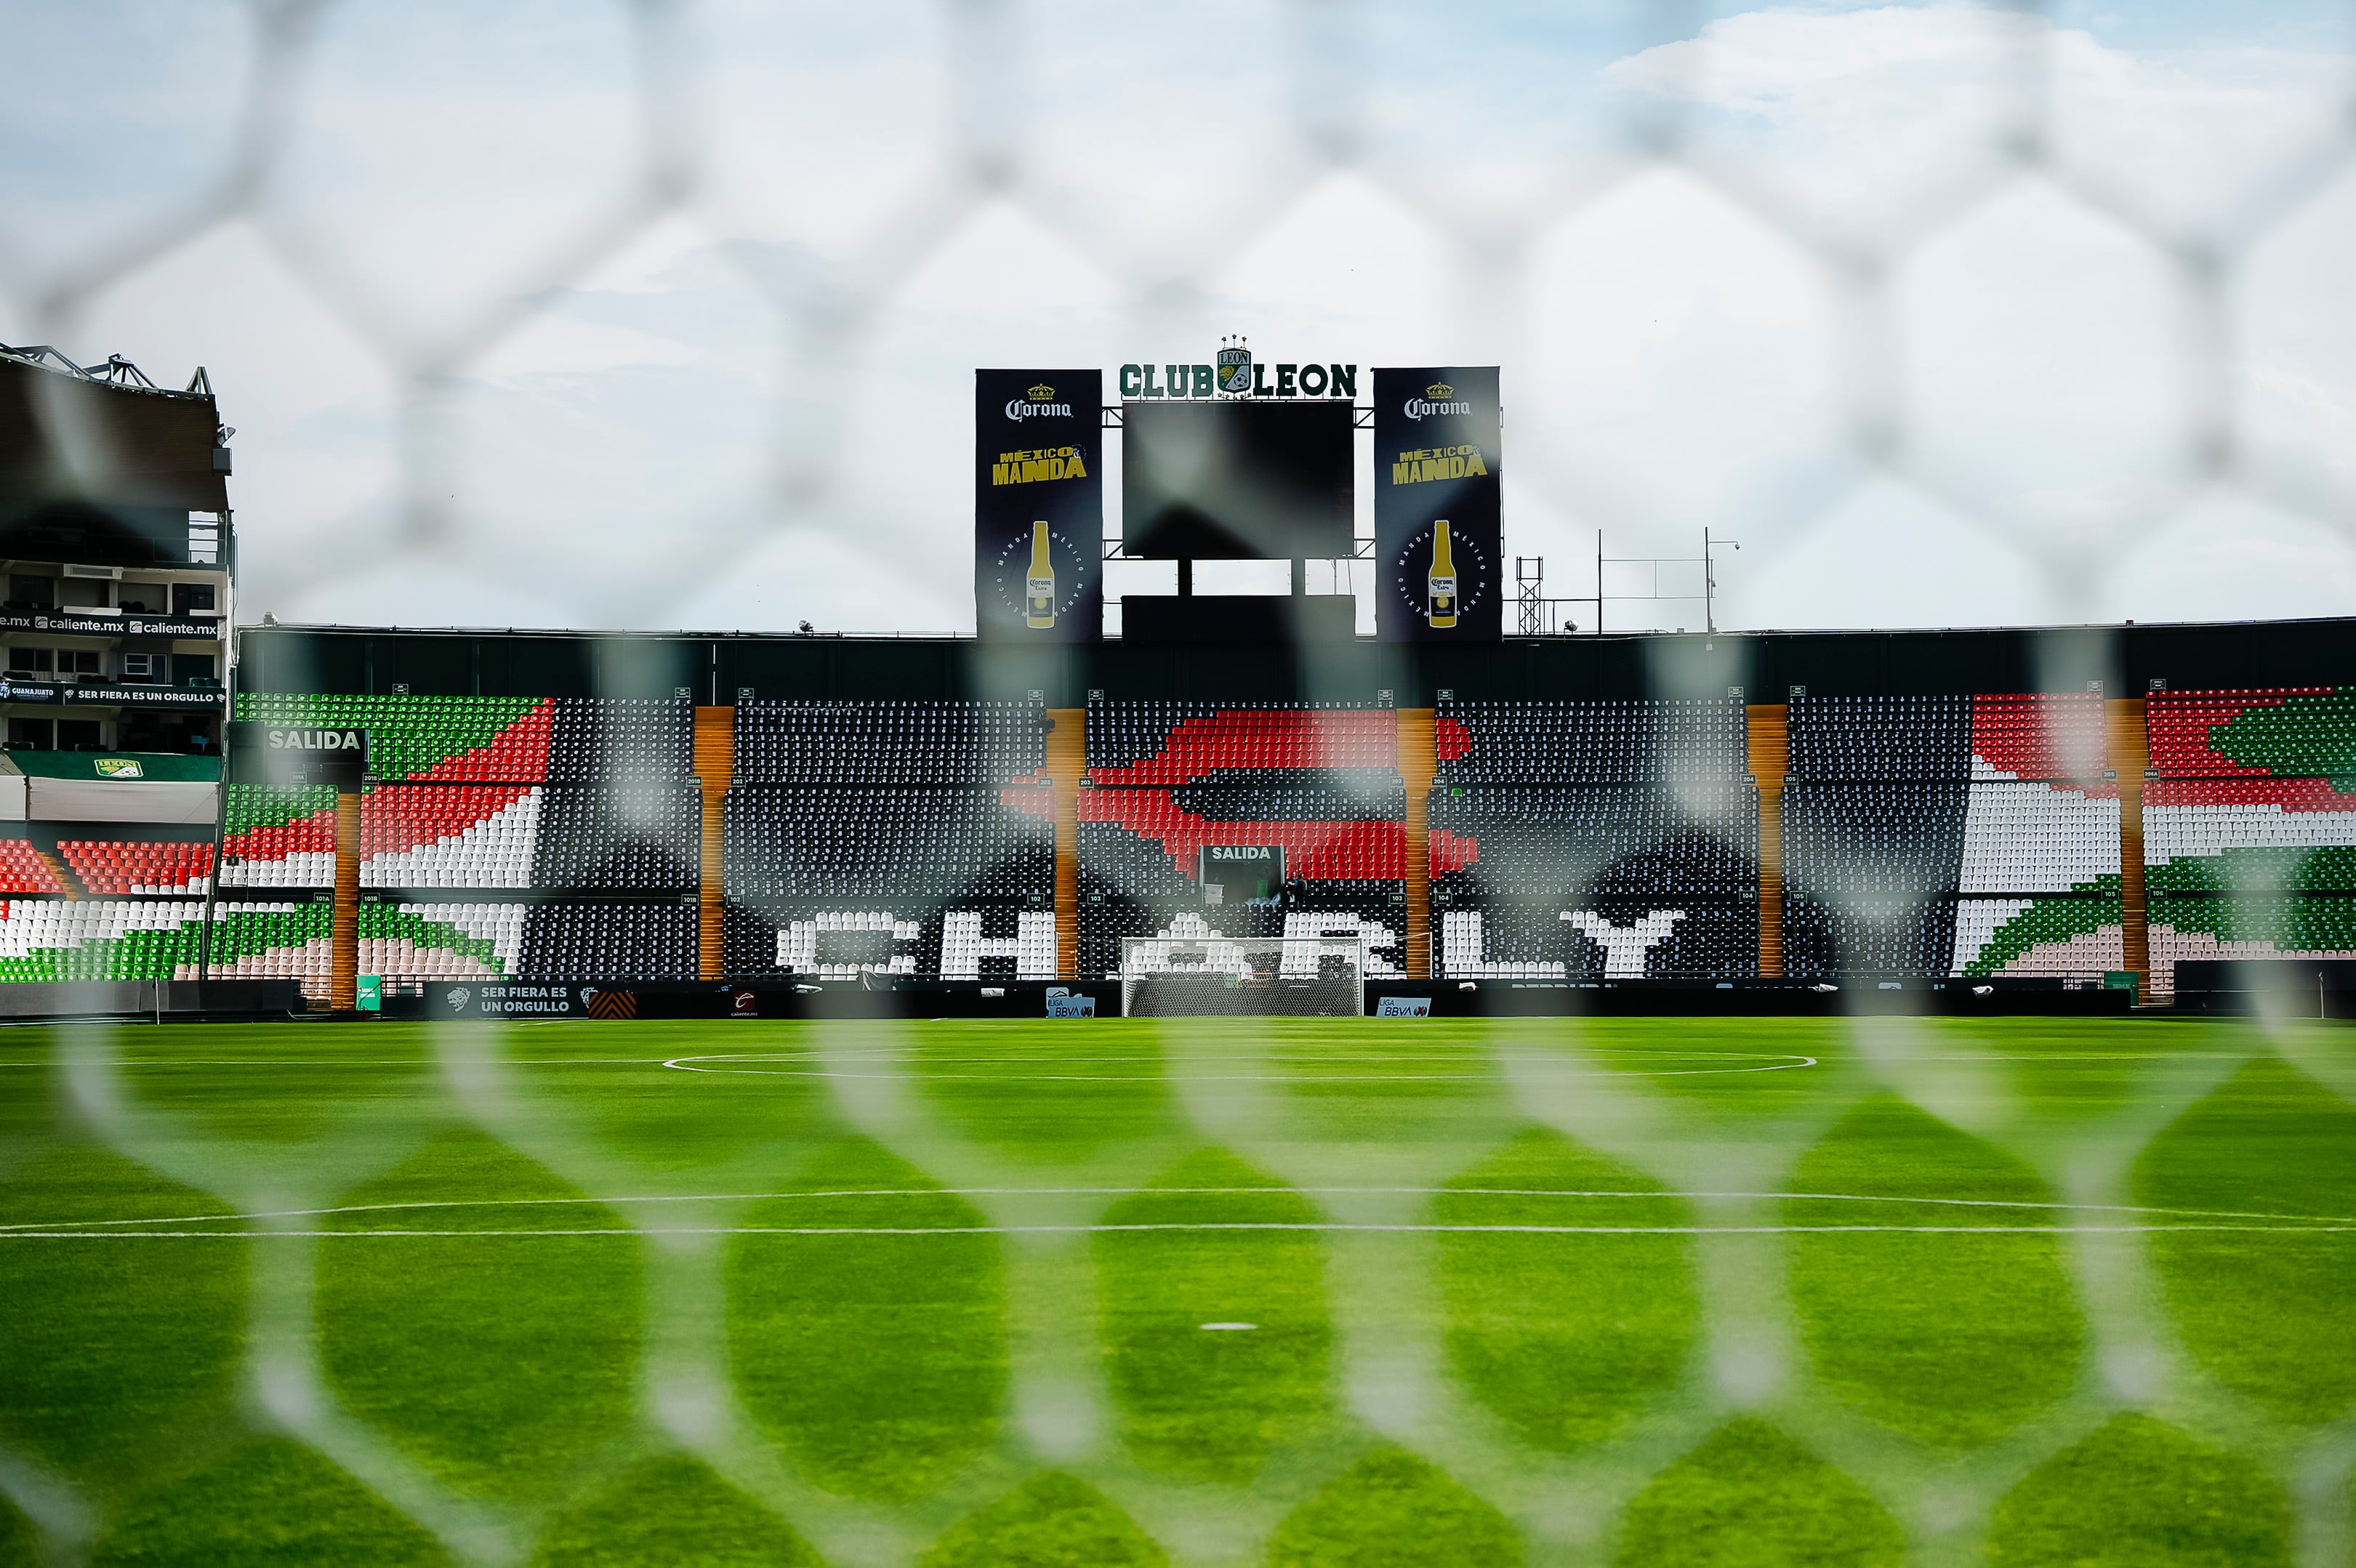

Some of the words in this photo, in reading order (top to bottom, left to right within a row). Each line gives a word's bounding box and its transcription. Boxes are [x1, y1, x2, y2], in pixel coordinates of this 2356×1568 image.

[1220, 351, 1248, 363] LEON
[1119, 363, 1214, 397] CLUB
[1253, 363, 1357, 397] LEON
[1005, 399, 1072, 422] Corona
[1402, 398, 1471, 422] Corona
[1000, 446, 1074, 463] MÉXICO
[1399, 444, 1474, 462] MÉXICO
[992, 457, 1087, 486] MANDA
[1393, 454, 1488, 486] MANDA
[997, 532, 1029, 567] MANDA
[1052, 532, 1085, 572] MÉXICO
[1399, 532, 1430, 566] MANDA
[1453, 531, 1486, 570] MÉXICO
[49, 618, 124, 632] caliente.mx
[143, 623, 217, 635] caliente.mx
[78, 690, 98, 699] SER
[100, 691, 131, 701] FIERA
[132, 691, 145, 700] ES
[146, 692, 161, 701] UN
[164, 693, 214, 702] ORGULLO
[269, 731, 360, 749] SALIDA
[1212, 847, 1271, 859] SALIDA
[481, 987, 506, 997] SER
[510, 987, 547, 997] FIERA
[551, 987, 567, 997] ES
[481, 1002, 502, 1012] UN
[504, 1002, 569, 1012] ORGULLO
[1055, 1007, 1080, 1017] BBVA
[1385, 1007, 1412, 1016] BBVA
